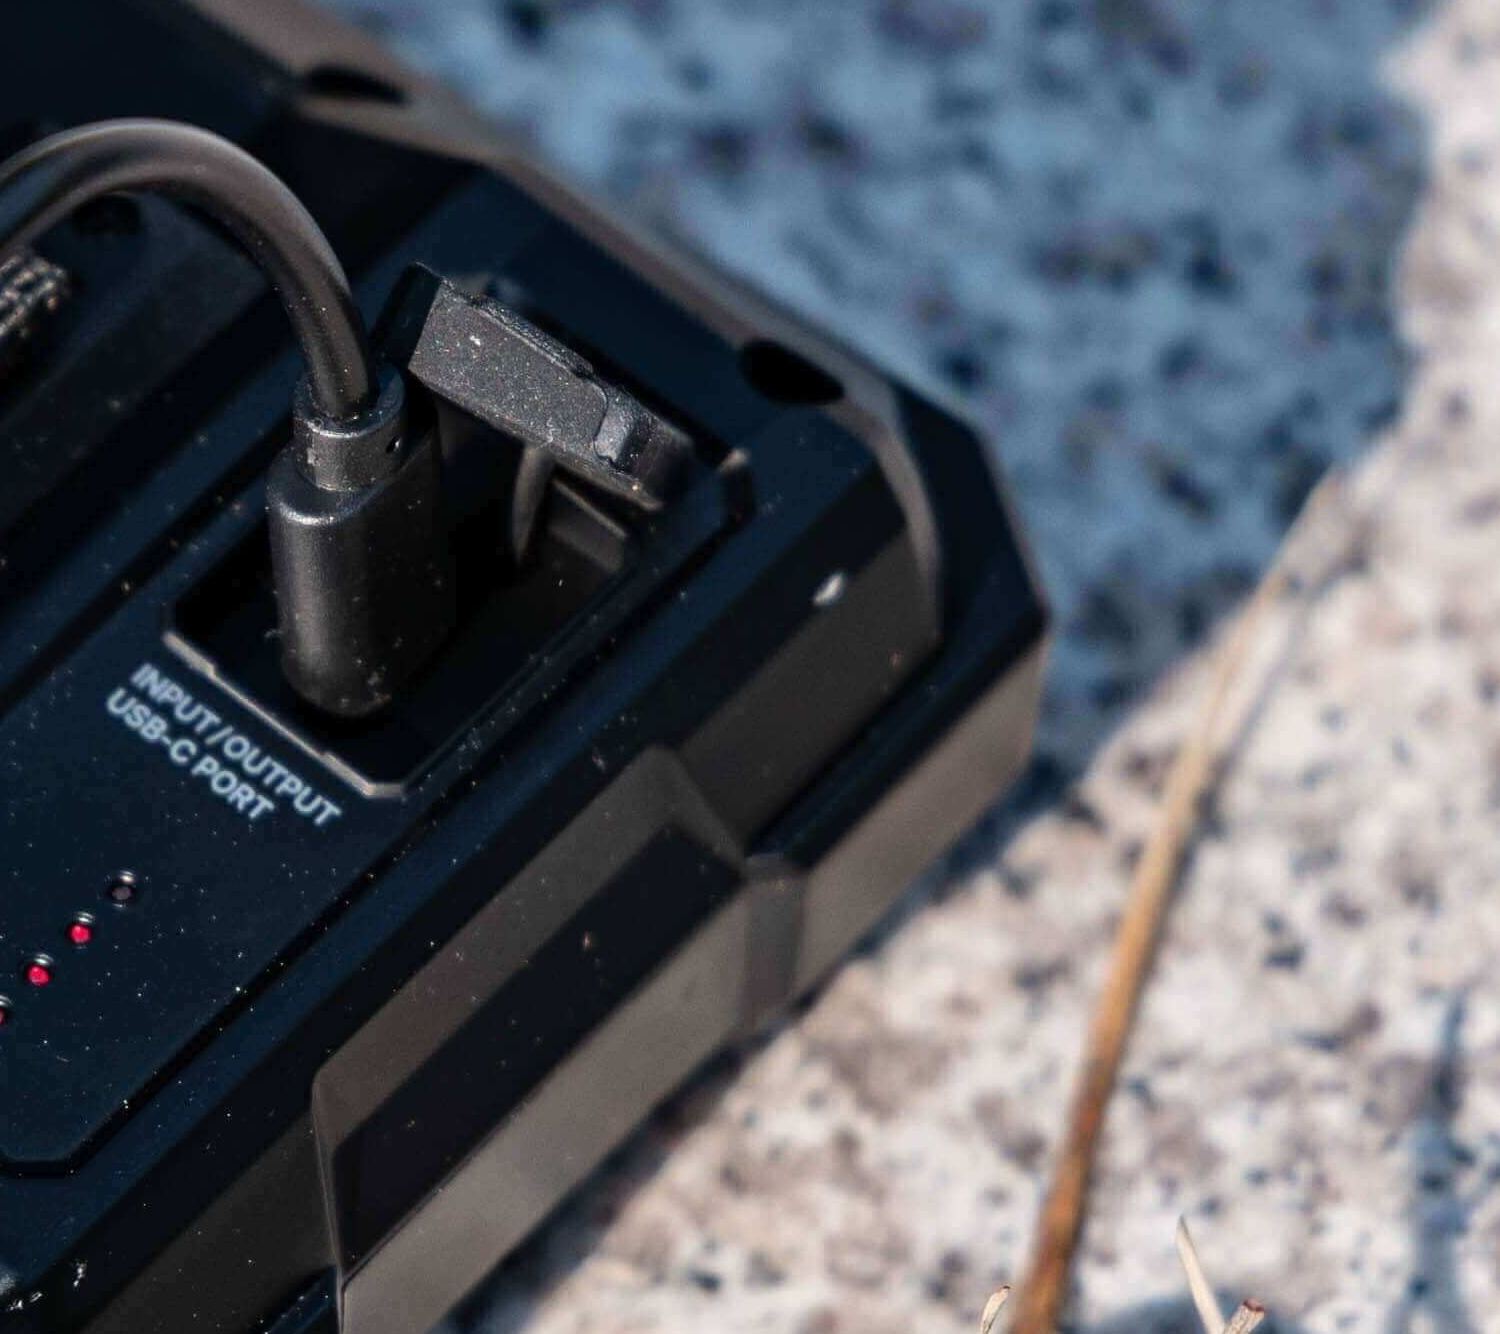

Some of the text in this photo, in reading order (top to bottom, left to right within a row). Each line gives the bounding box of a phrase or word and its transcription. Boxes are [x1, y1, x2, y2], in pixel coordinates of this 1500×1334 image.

[106, 687, 276, 820] USB-C PORT
[129, 663, 343, 826] INPUT/OUTPUT
